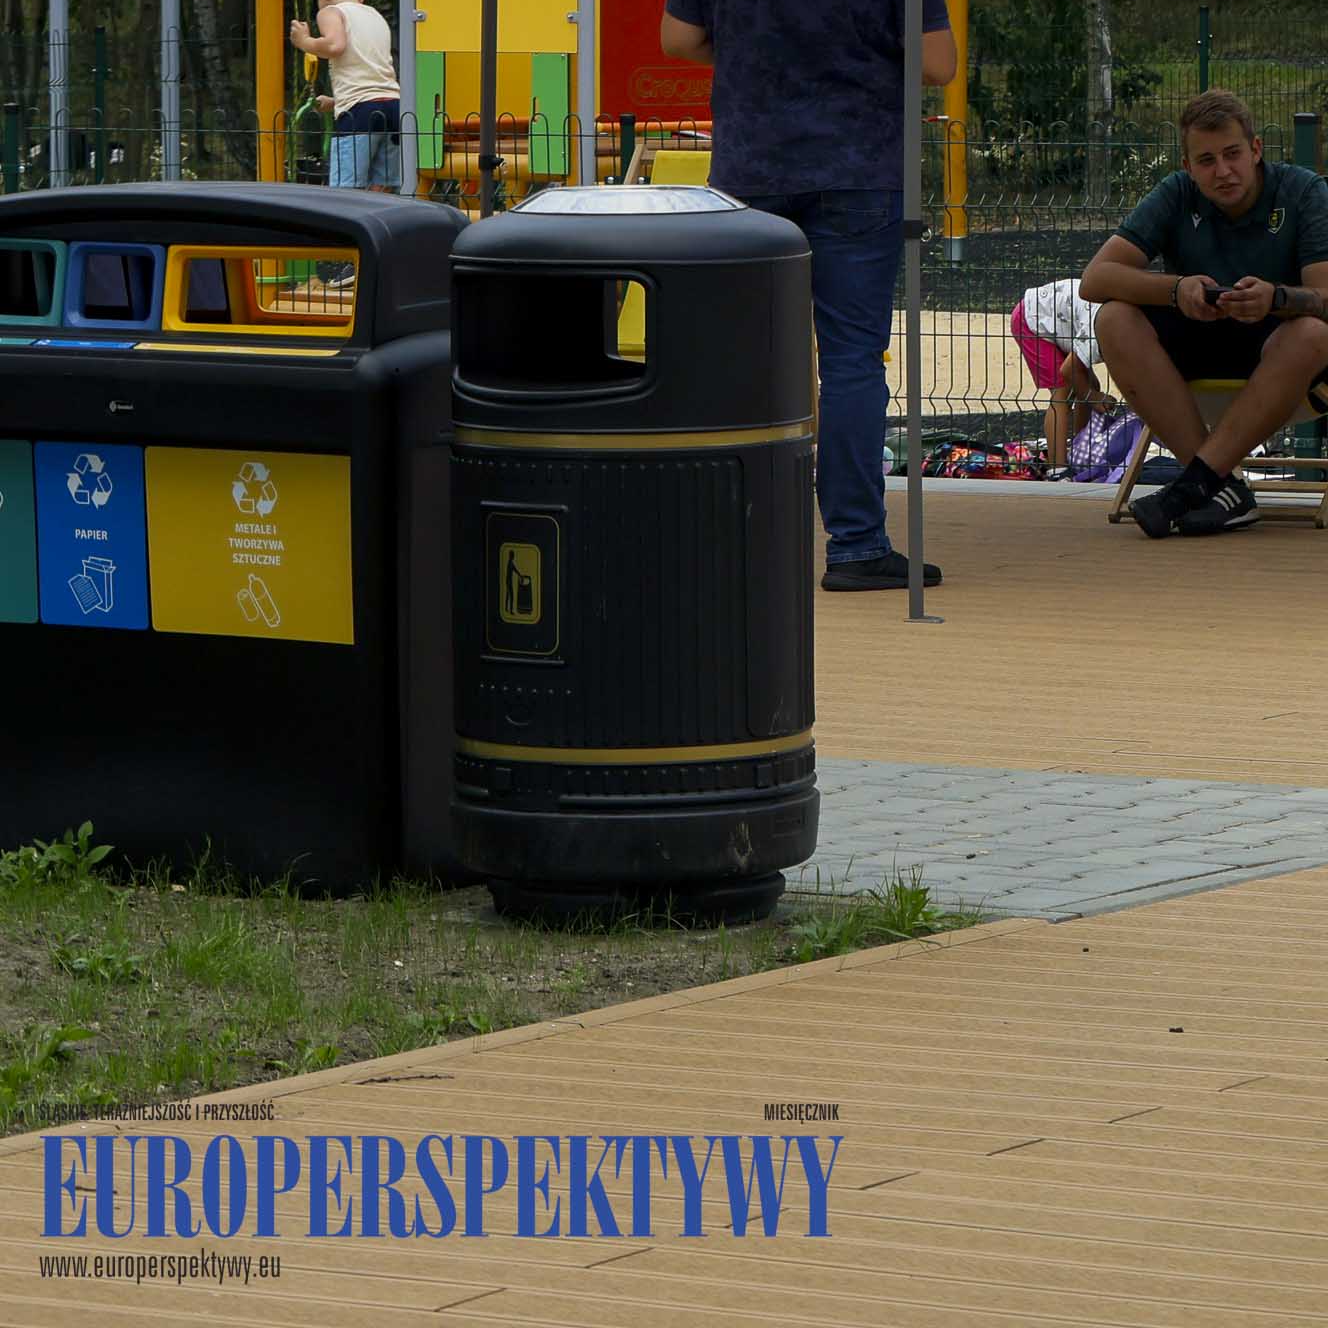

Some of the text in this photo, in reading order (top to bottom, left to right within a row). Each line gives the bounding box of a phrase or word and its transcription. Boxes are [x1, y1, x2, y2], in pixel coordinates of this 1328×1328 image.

[75, 528, 108, 541] PAPIER
[235, 523, 272, 535] METALE
[228, 537, 285, 551] TWORZYWA
[232, 552, 281, 566] SZTUCZNE
